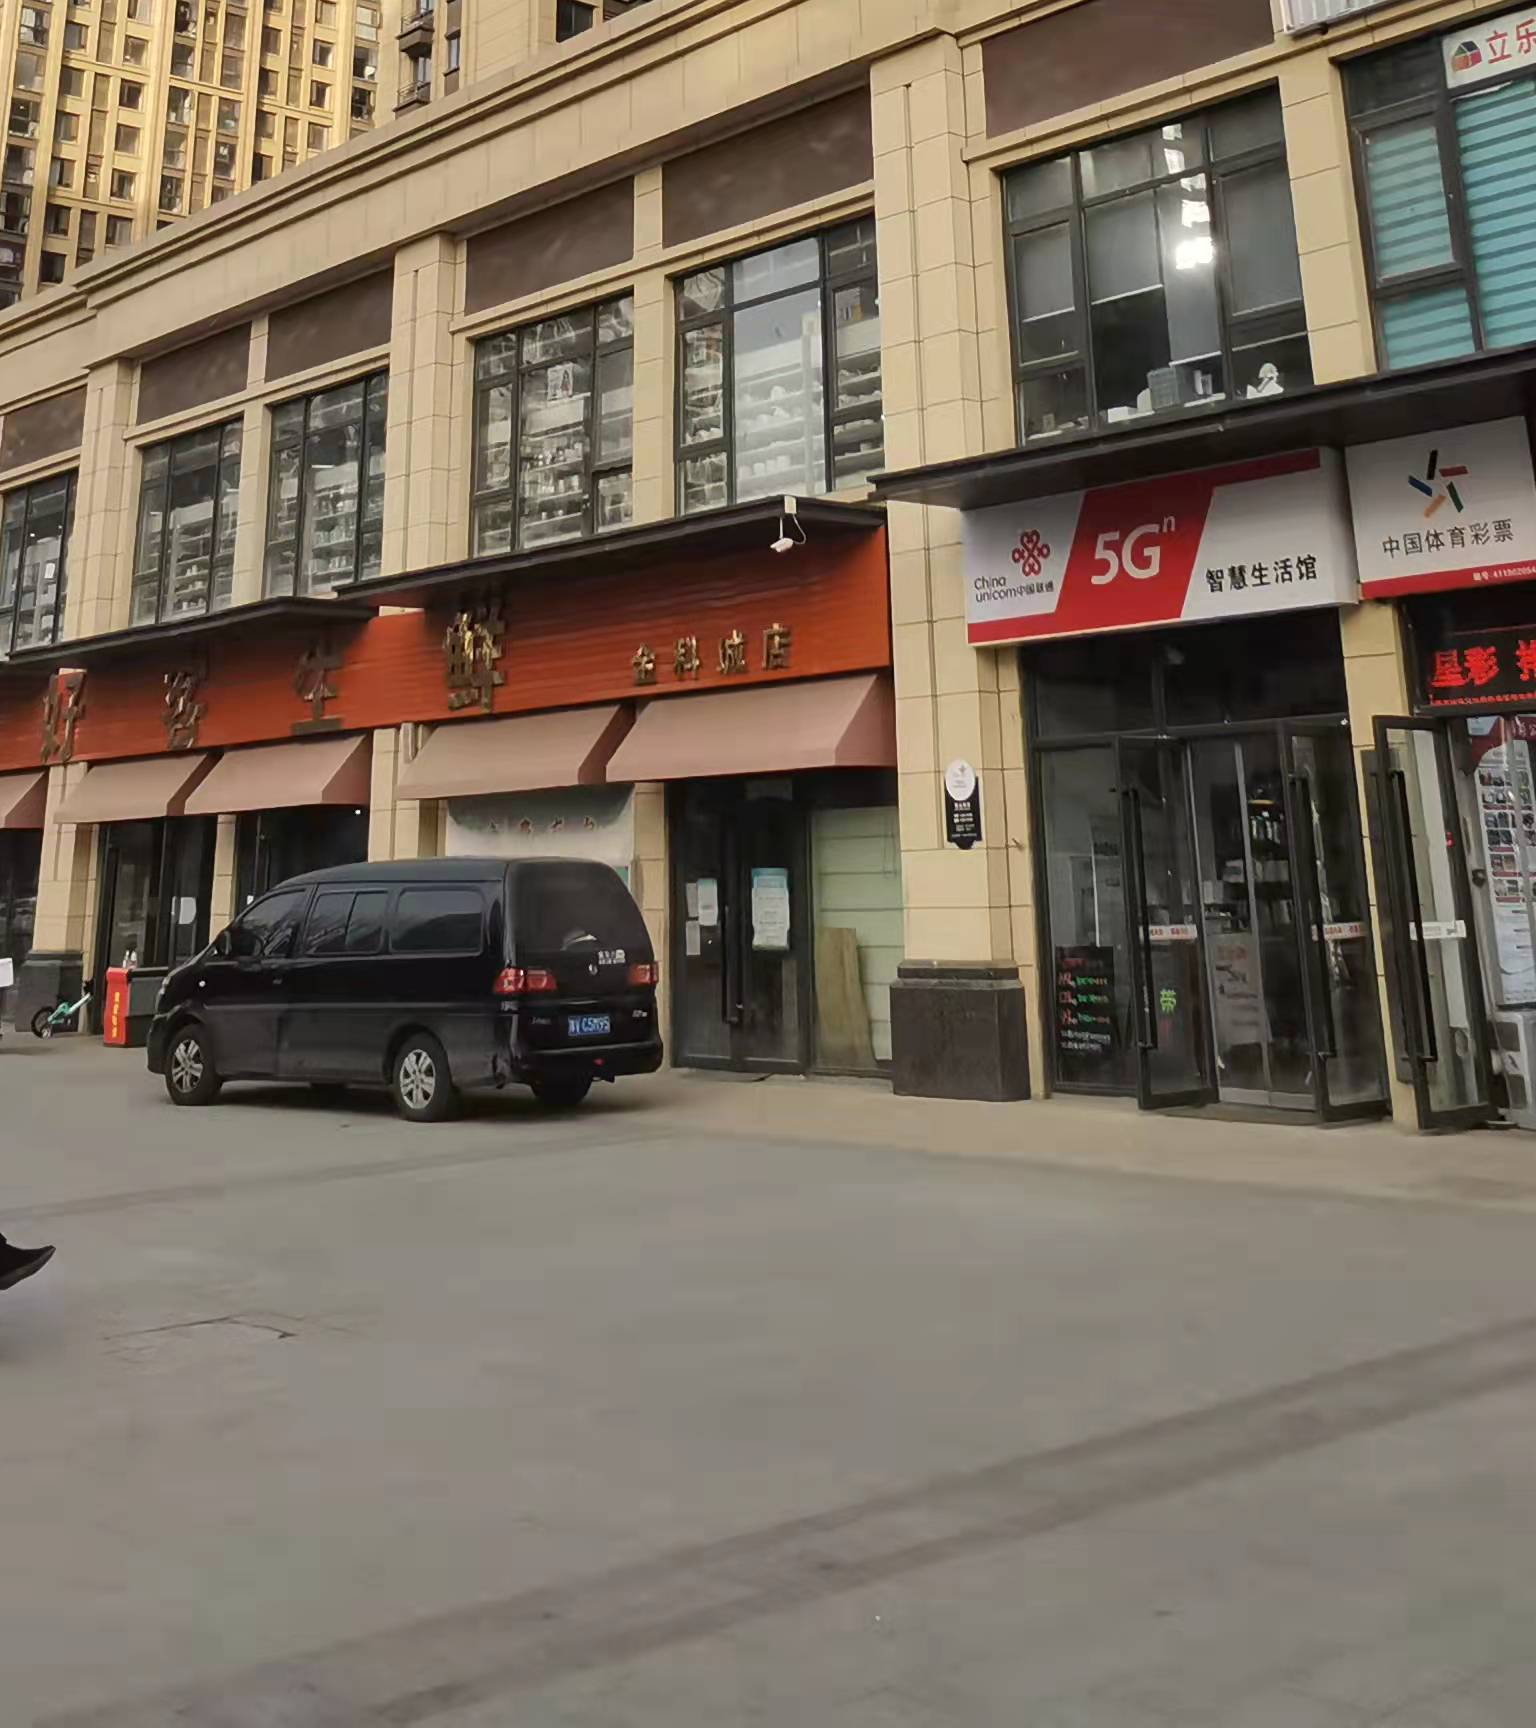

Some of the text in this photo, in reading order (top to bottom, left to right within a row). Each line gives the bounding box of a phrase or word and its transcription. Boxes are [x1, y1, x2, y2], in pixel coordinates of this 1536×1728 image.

[1383, 518, 1515, 558] 中国体育彩票
[974, 576, 1007, 591] China
[1206, 554, 1317, 593] 智慧生活馆
